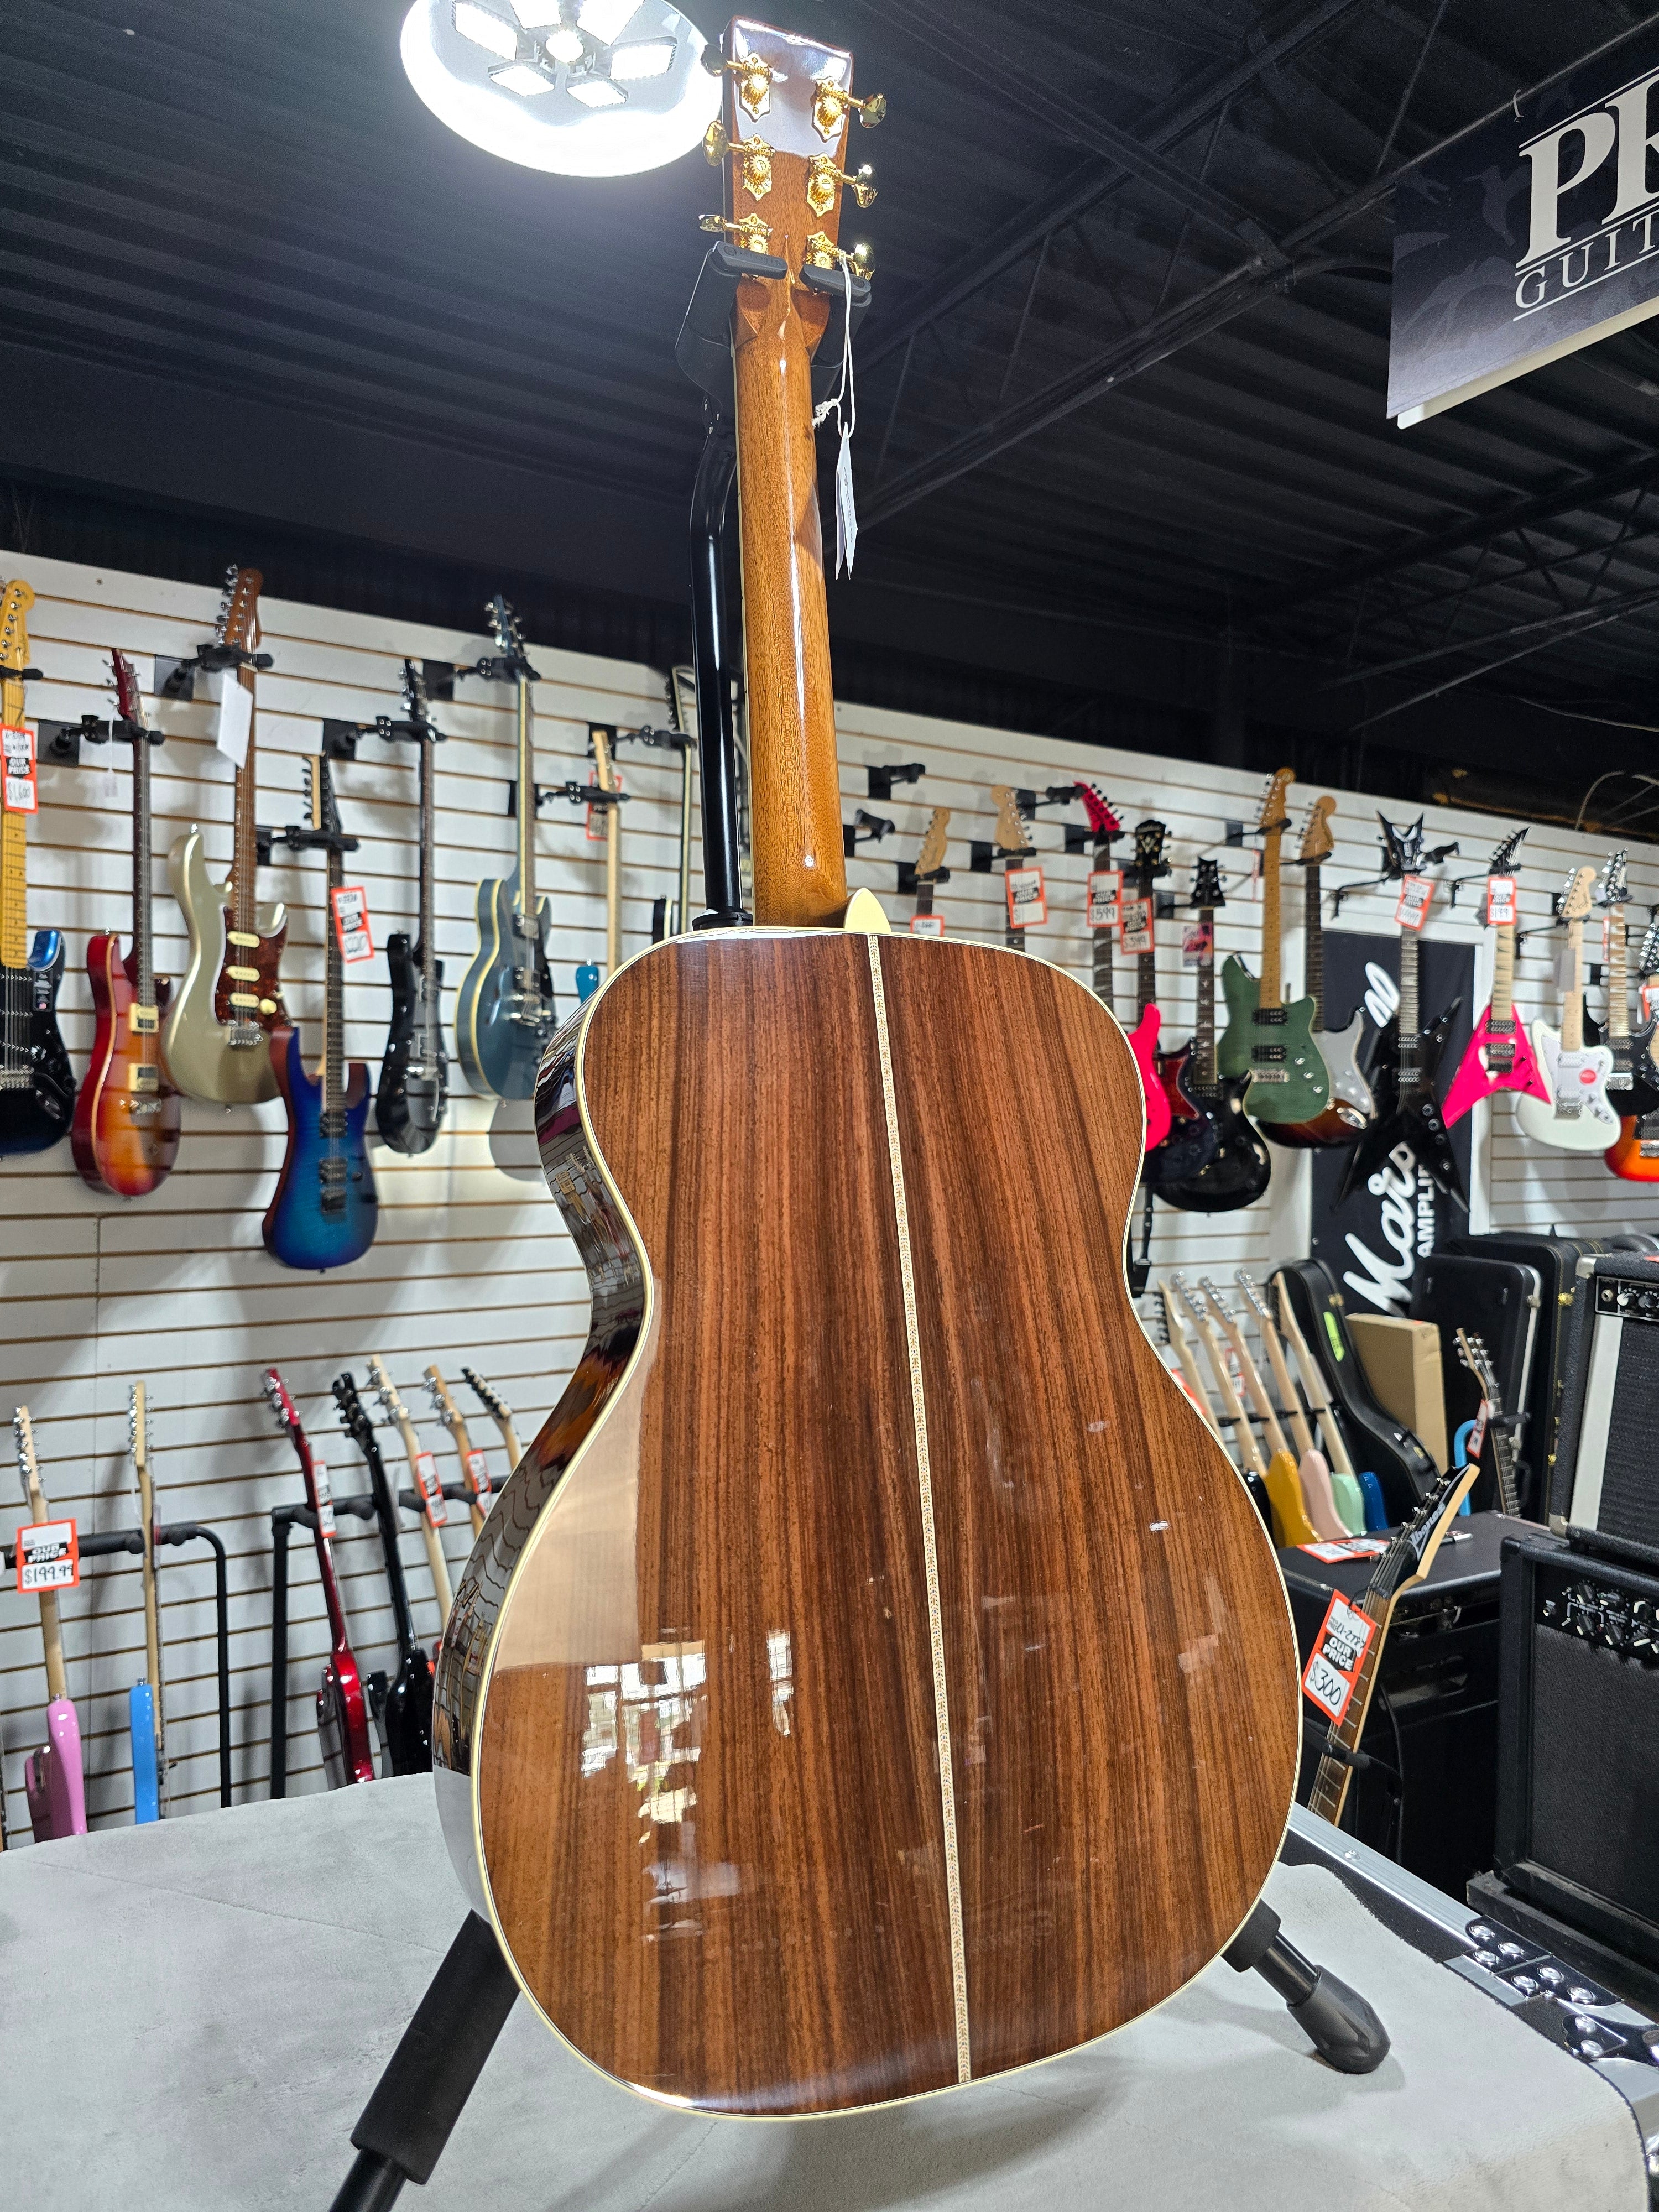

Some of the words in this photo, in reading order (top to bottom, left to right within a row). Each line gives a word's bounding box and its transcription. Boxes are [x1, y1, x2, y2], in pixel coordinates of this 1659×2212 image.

[28, 1548, 67, 1564] PRICE
[32, 1543, 60, 1555] OUR
[25, 1564, 73, 1585] $199.99
[1329, 1637, 1352, 1657] OUR
[1322, 1644, 1354, 1671] PRICE
[1308, 1661, 1342, 1706] $300
